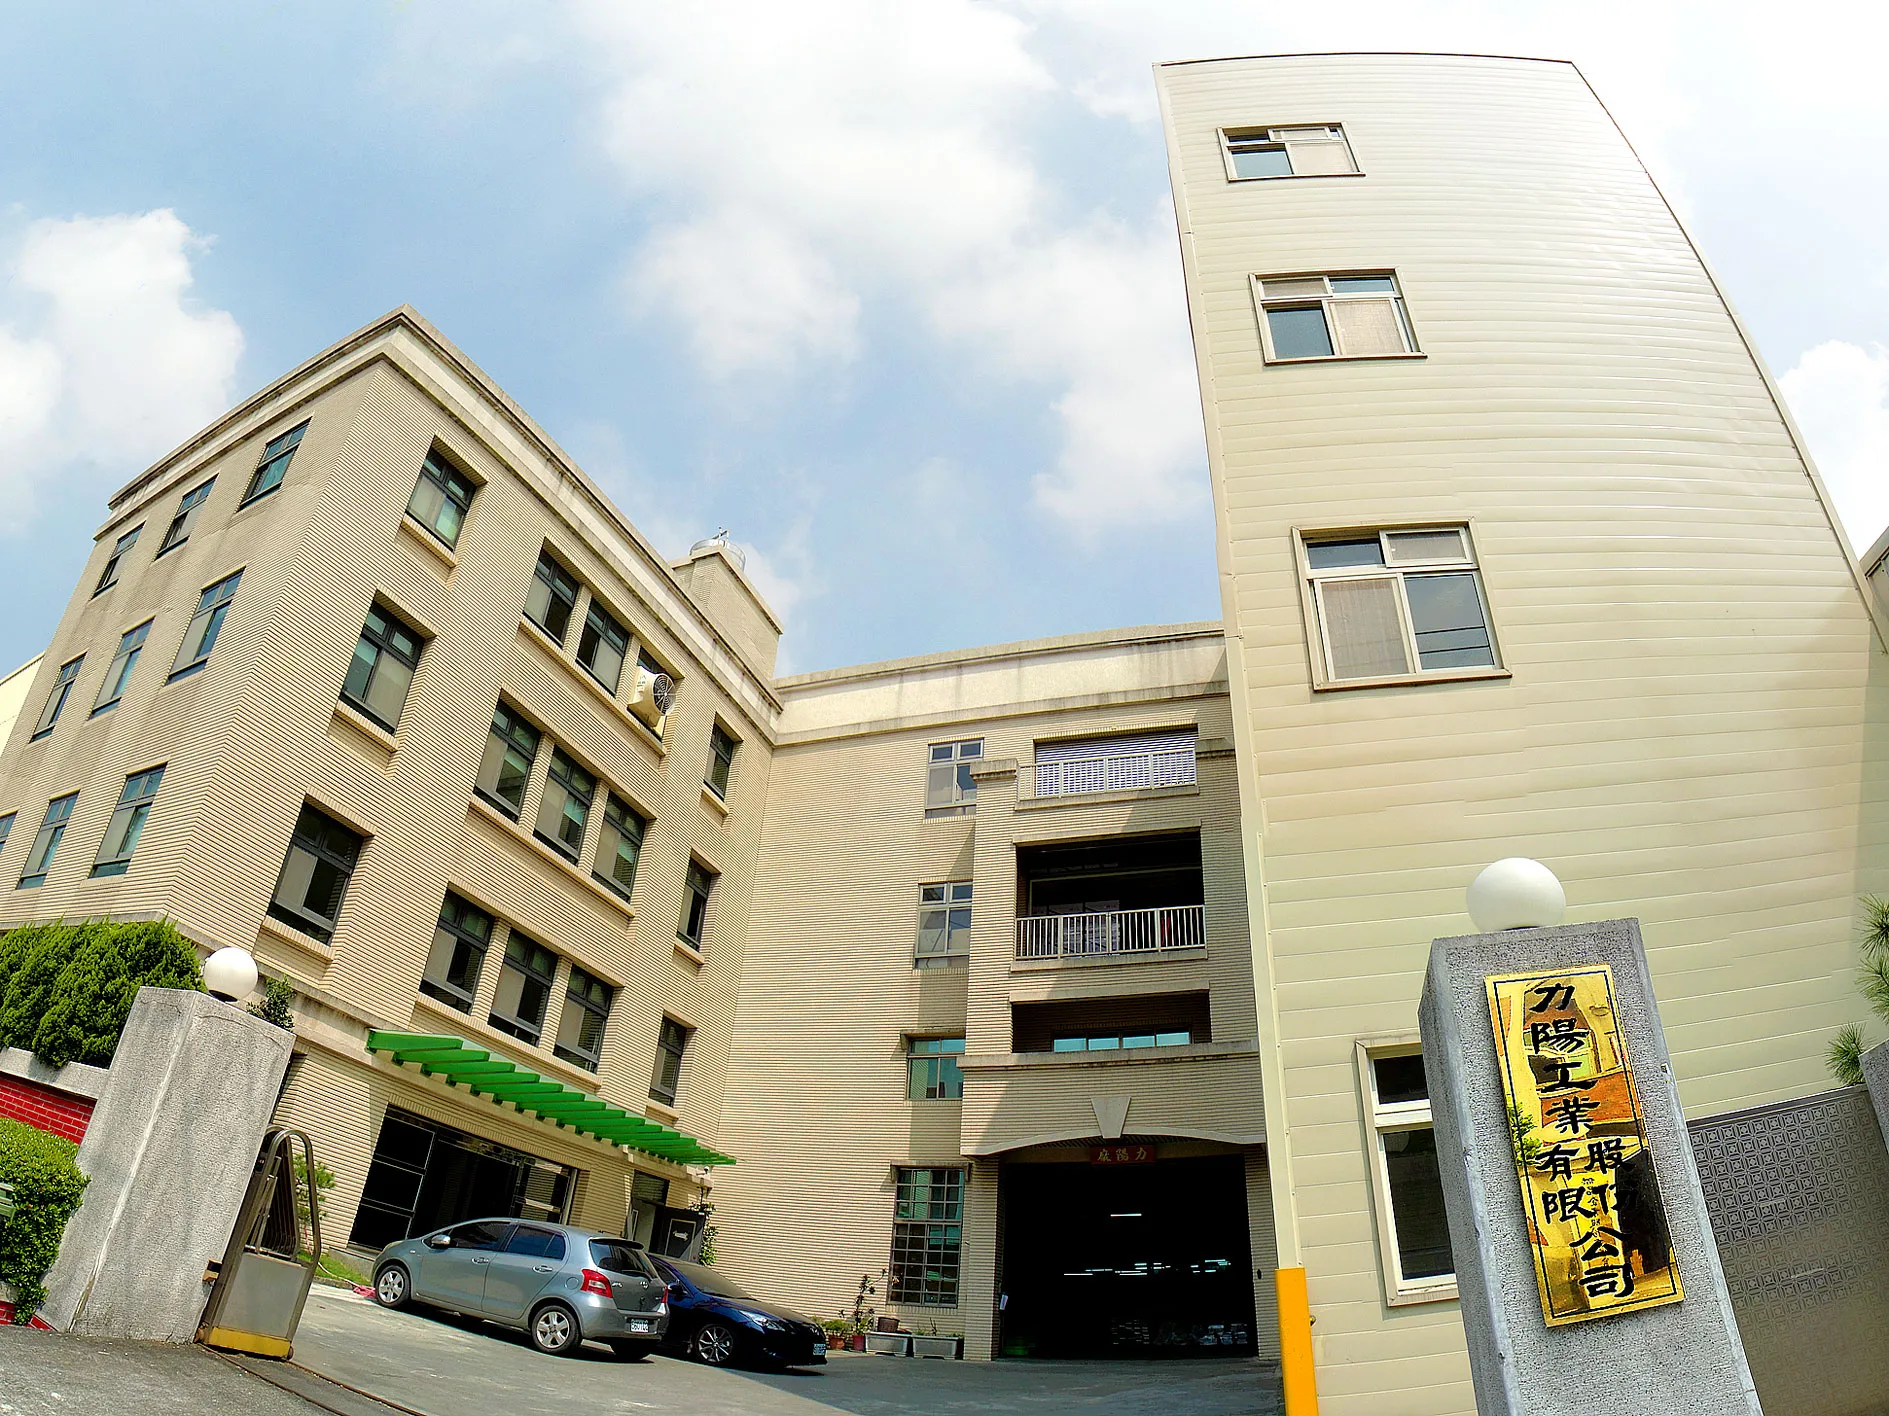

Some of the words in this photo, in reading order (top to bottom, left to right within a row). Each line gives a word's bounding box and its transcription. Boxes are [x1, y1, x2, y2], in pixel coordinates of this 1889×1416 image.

[1530, 983, 1601, 1135] 力陽工業
[1536, 1147, 1594, 1224] 有限
[1568, 1226, 1635, 1299] 公司
